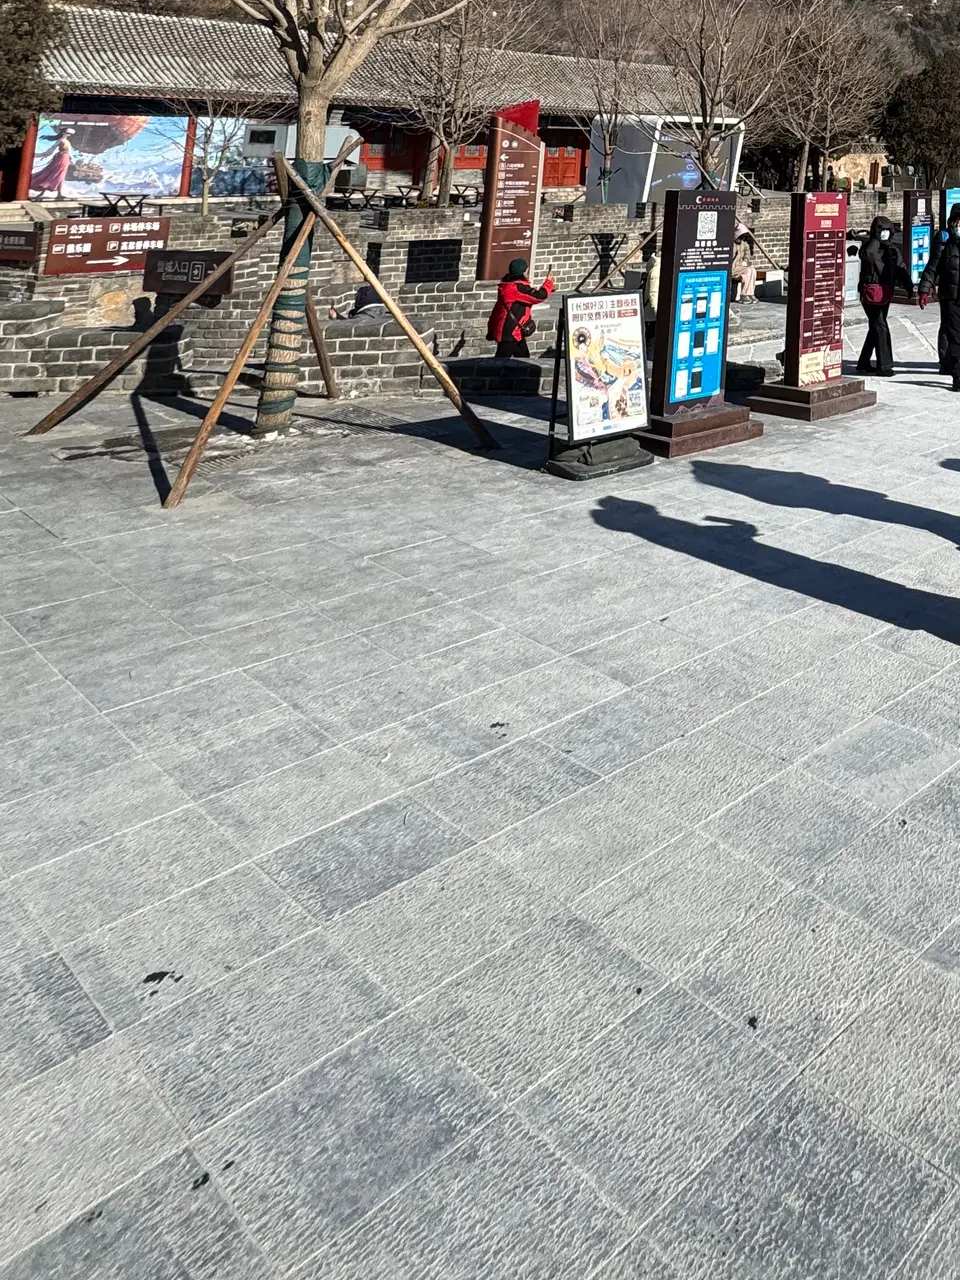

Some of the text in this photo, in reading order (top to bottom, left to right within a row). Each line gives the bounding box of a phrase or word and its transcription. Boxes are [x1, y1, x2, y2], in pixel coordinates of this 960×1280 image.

[156, 260, 189, 273] 登城入口
[161, 272, 188, 282] Entrance
